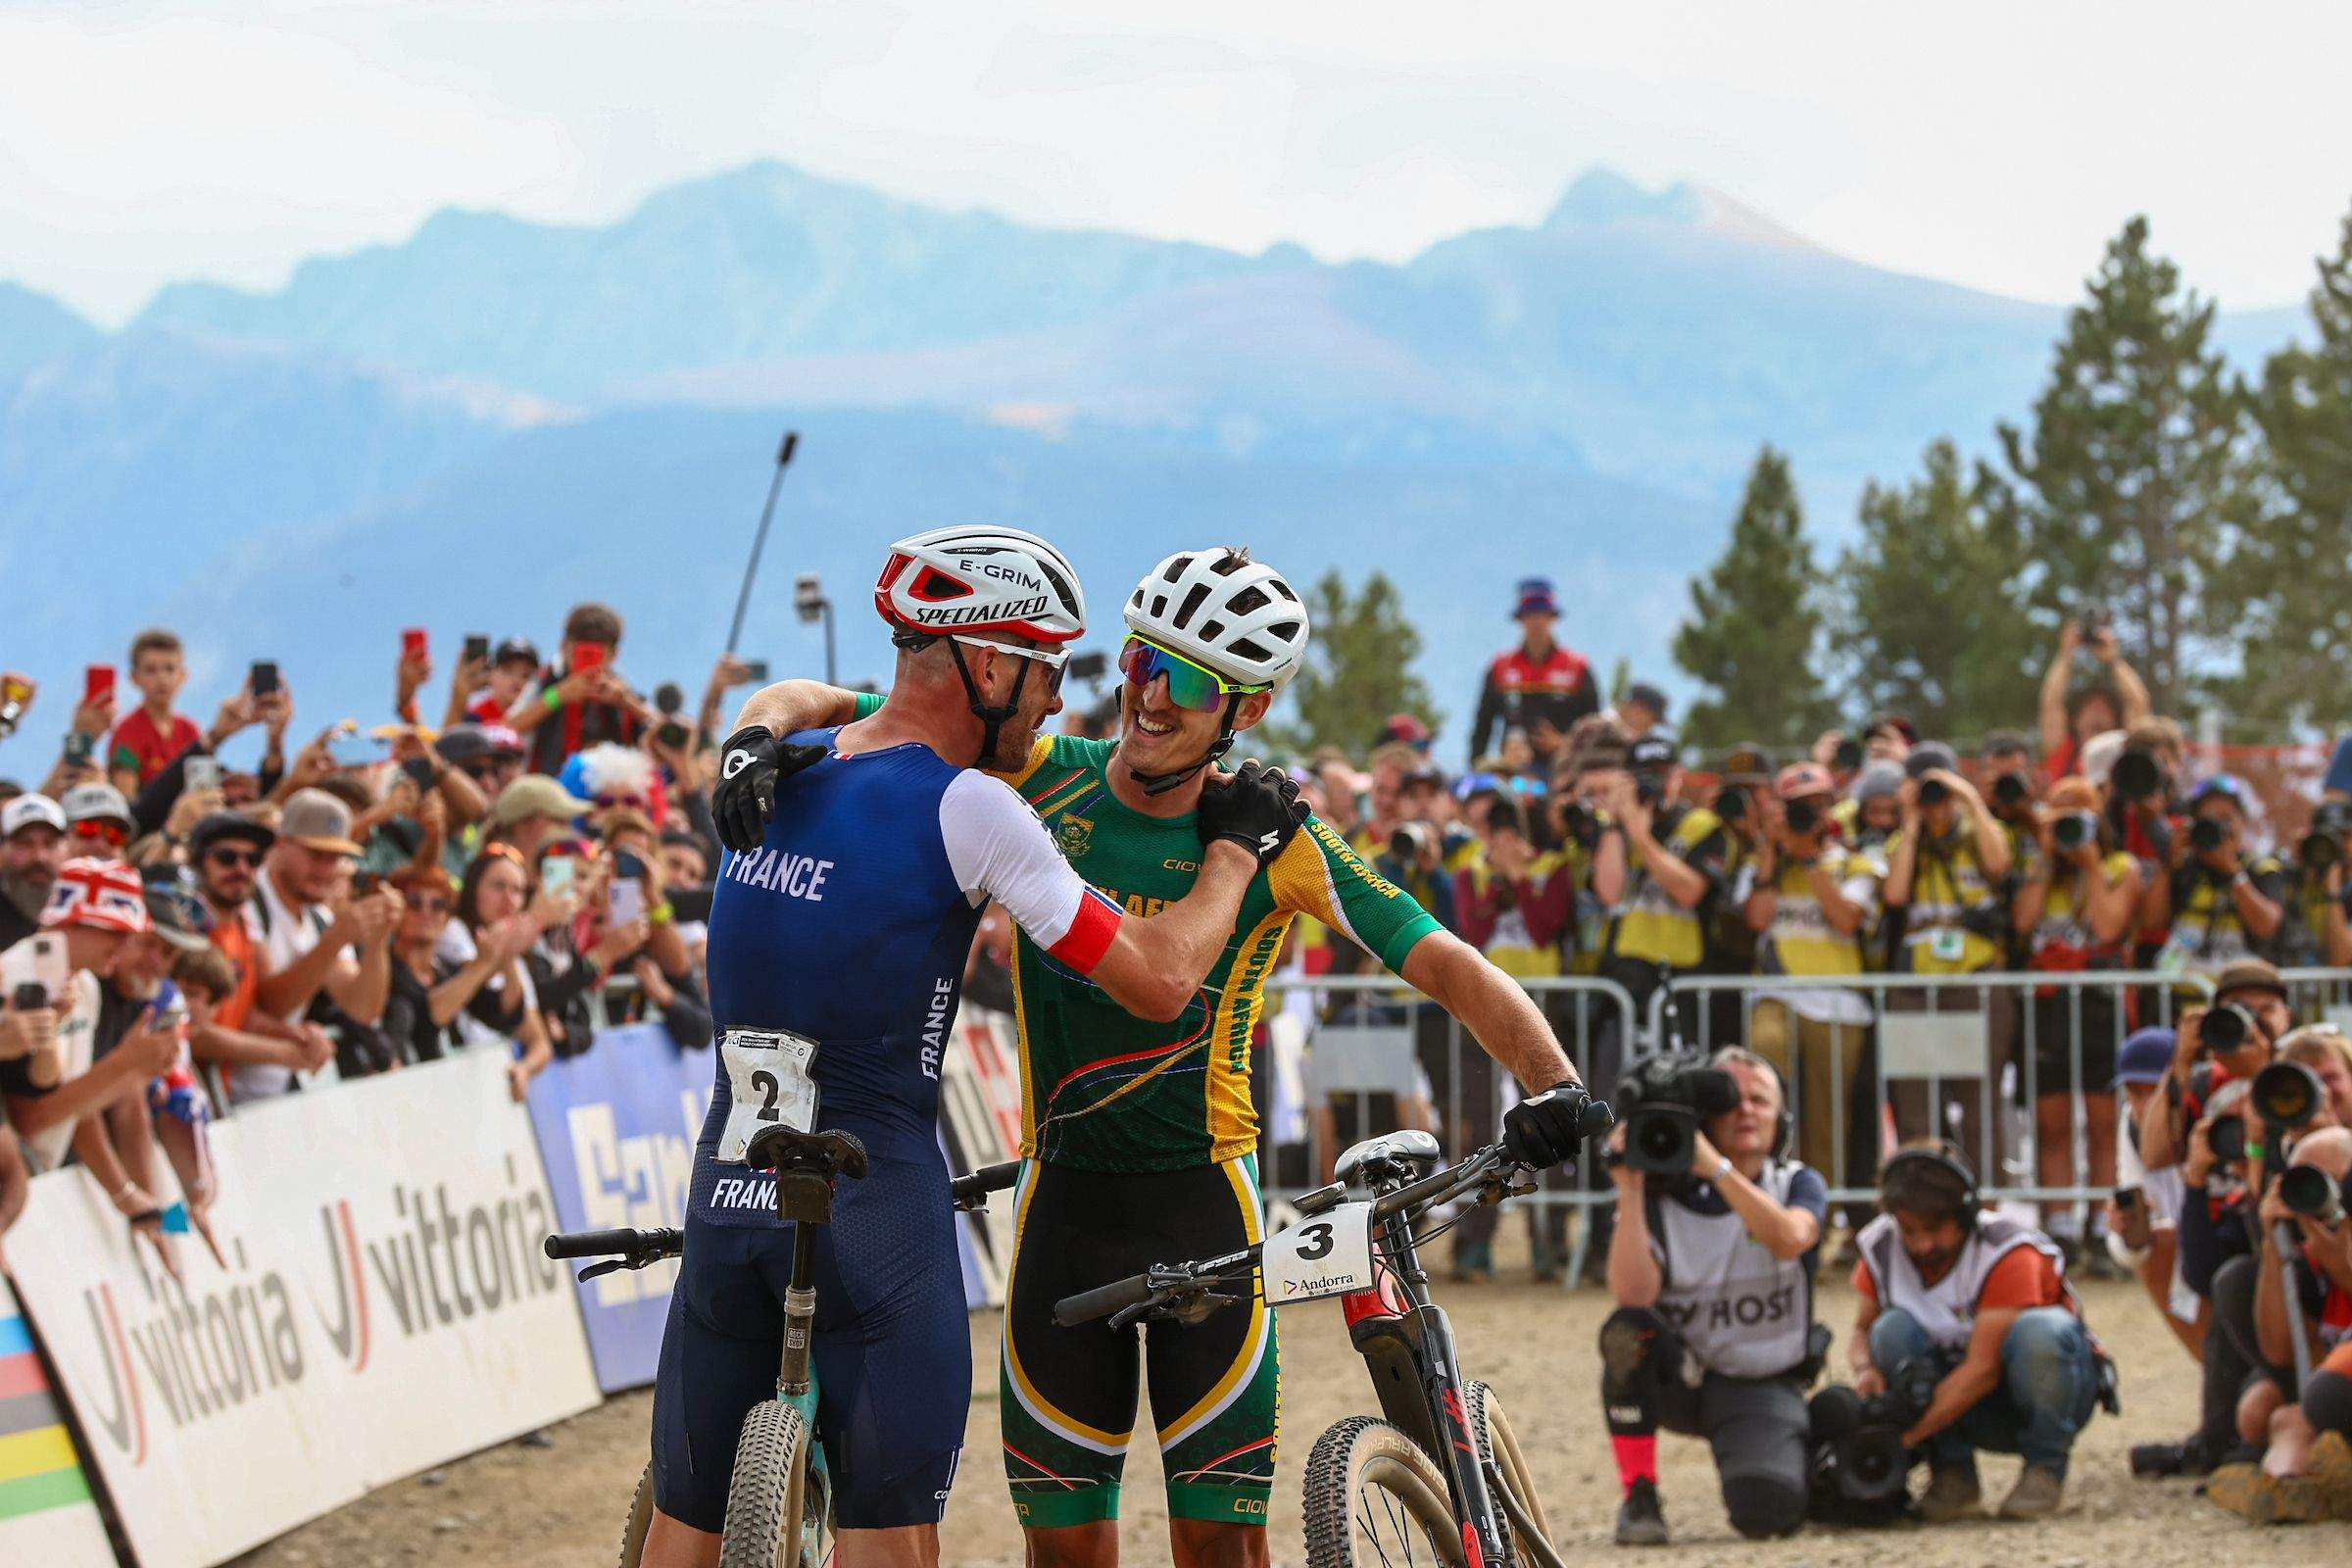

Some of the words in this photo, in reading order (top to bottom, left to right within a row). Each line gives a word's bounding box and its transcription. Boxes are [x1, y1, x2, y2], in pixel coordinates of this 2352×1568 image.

[959, 559, 1042, 592] E-GRIM
[915, 596, 1048, 624] SPECIALIZED
[1310, 822, 1356, 863] SOUTH
[725, 846, 834, 902] FRANCE
[921, 977, 953, 1082] FRANCE
[751, 1070, 780, 1122] 2
[367, 1152, 558, 1337] vittoria
[1296, 1223, 1334, 1261] 3
[1299, 1274, 1354, 1292] Andorra
